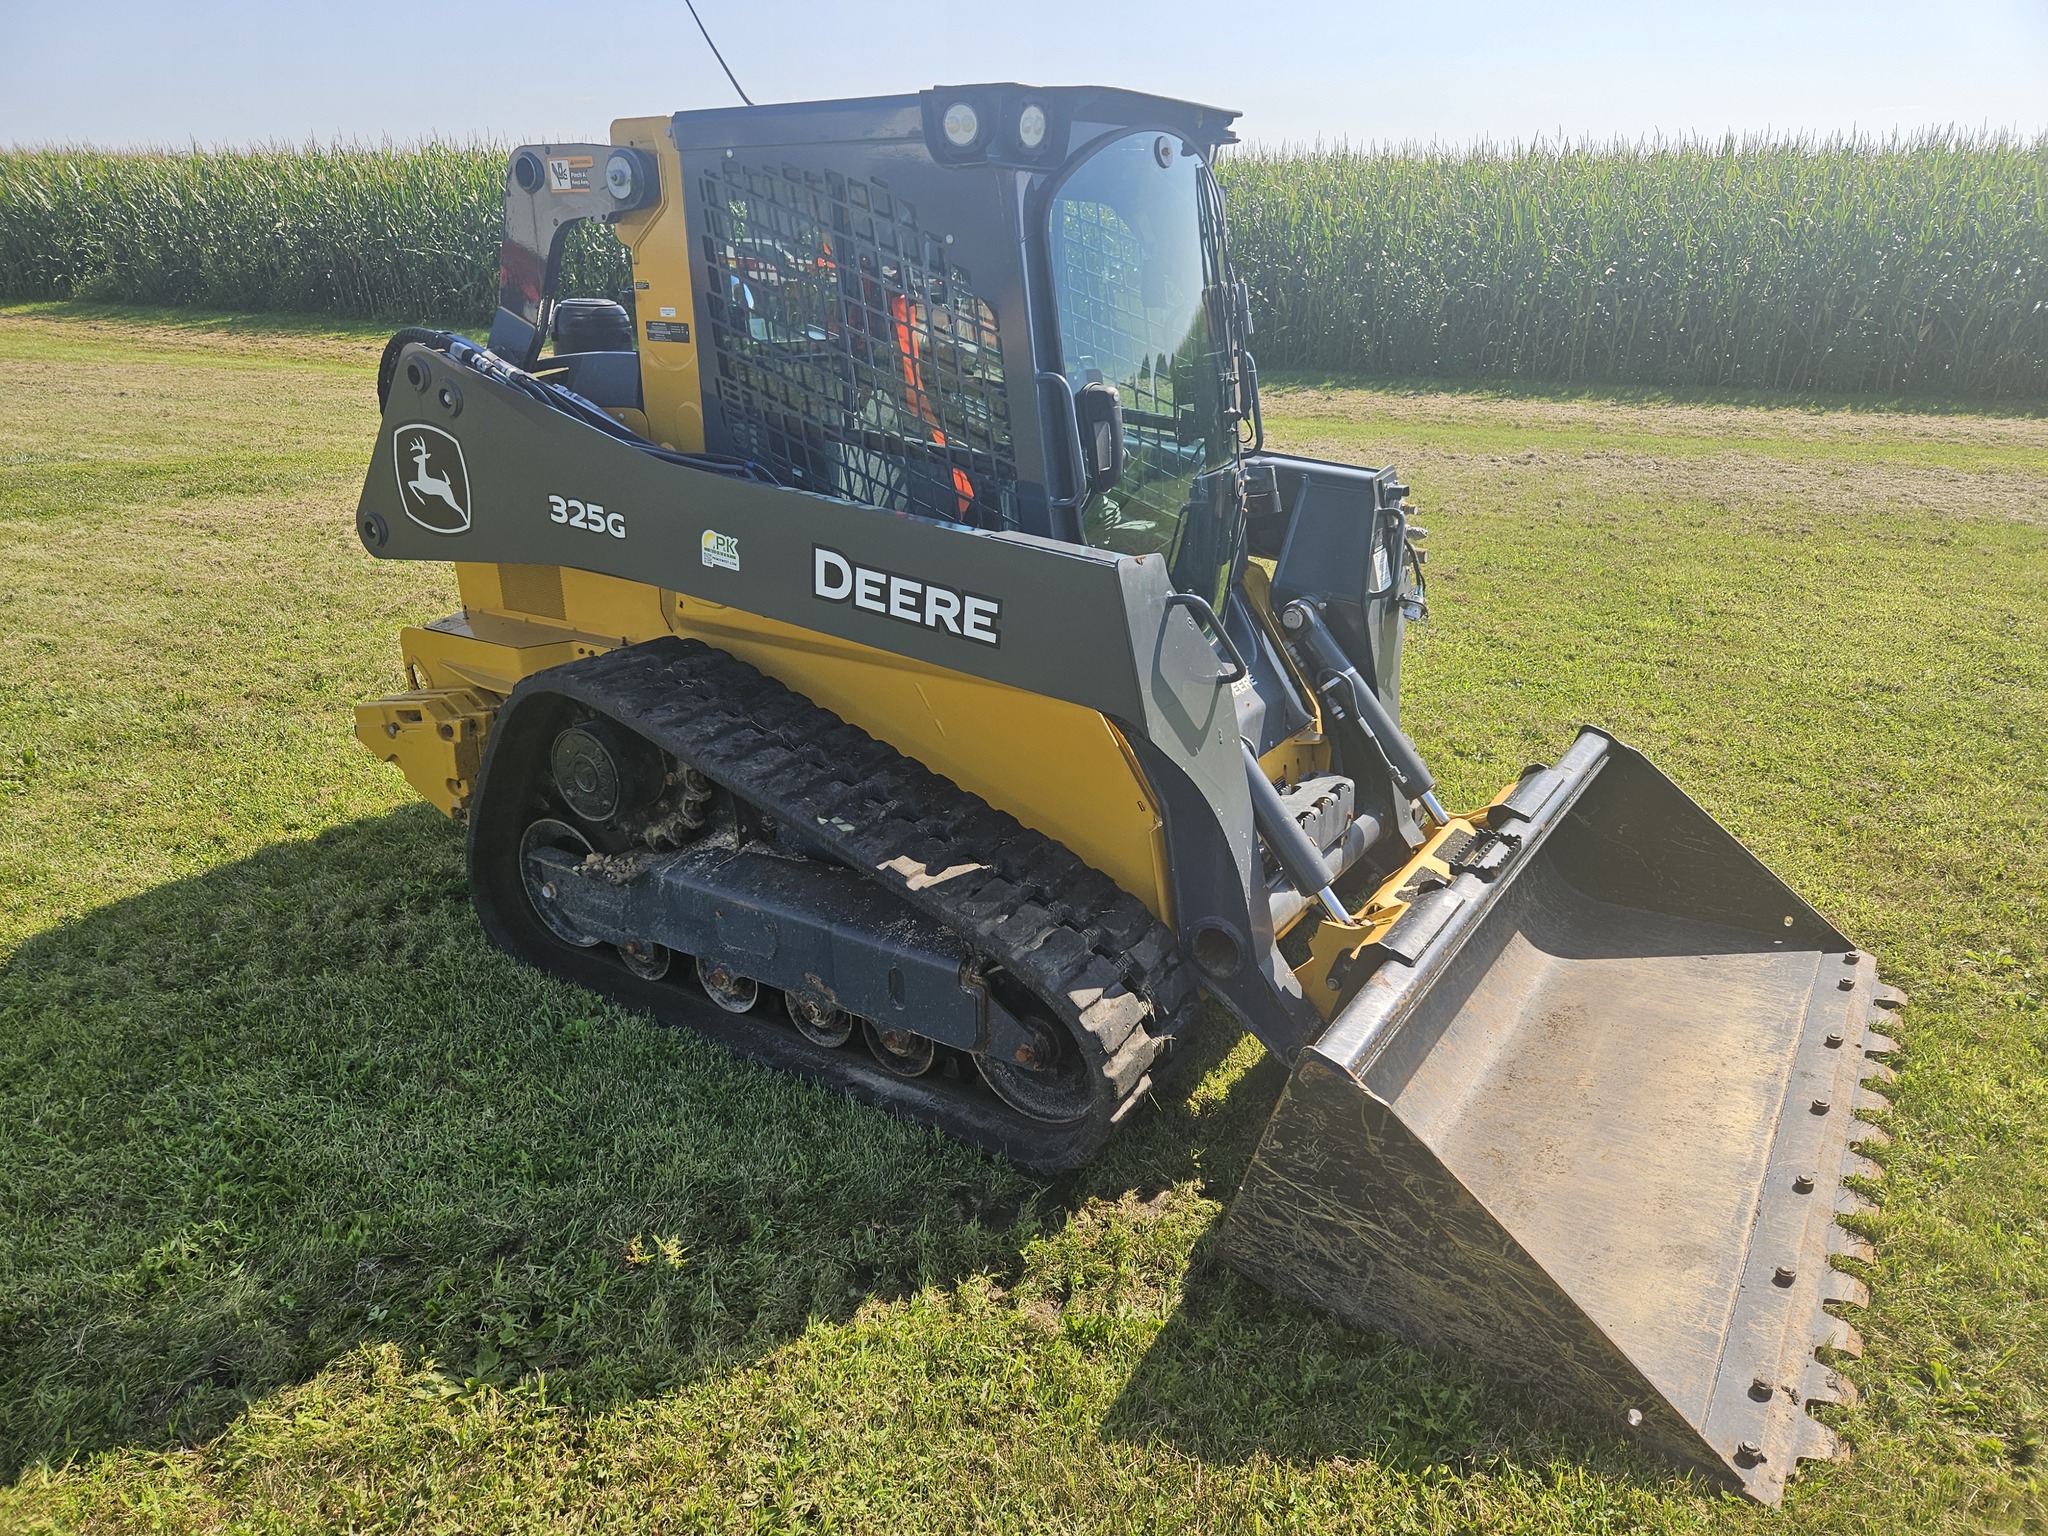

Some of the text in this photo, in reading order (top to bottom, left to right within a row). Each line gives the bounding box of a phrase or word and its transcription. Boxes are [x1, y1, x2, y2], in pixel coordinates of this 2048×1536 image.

[548, 495, 626, 538] 325G
[716, 535, 736, 555] PK
[815, 548, 998, 644] DEERE
[1230, 673, 1258, 698] EERE
